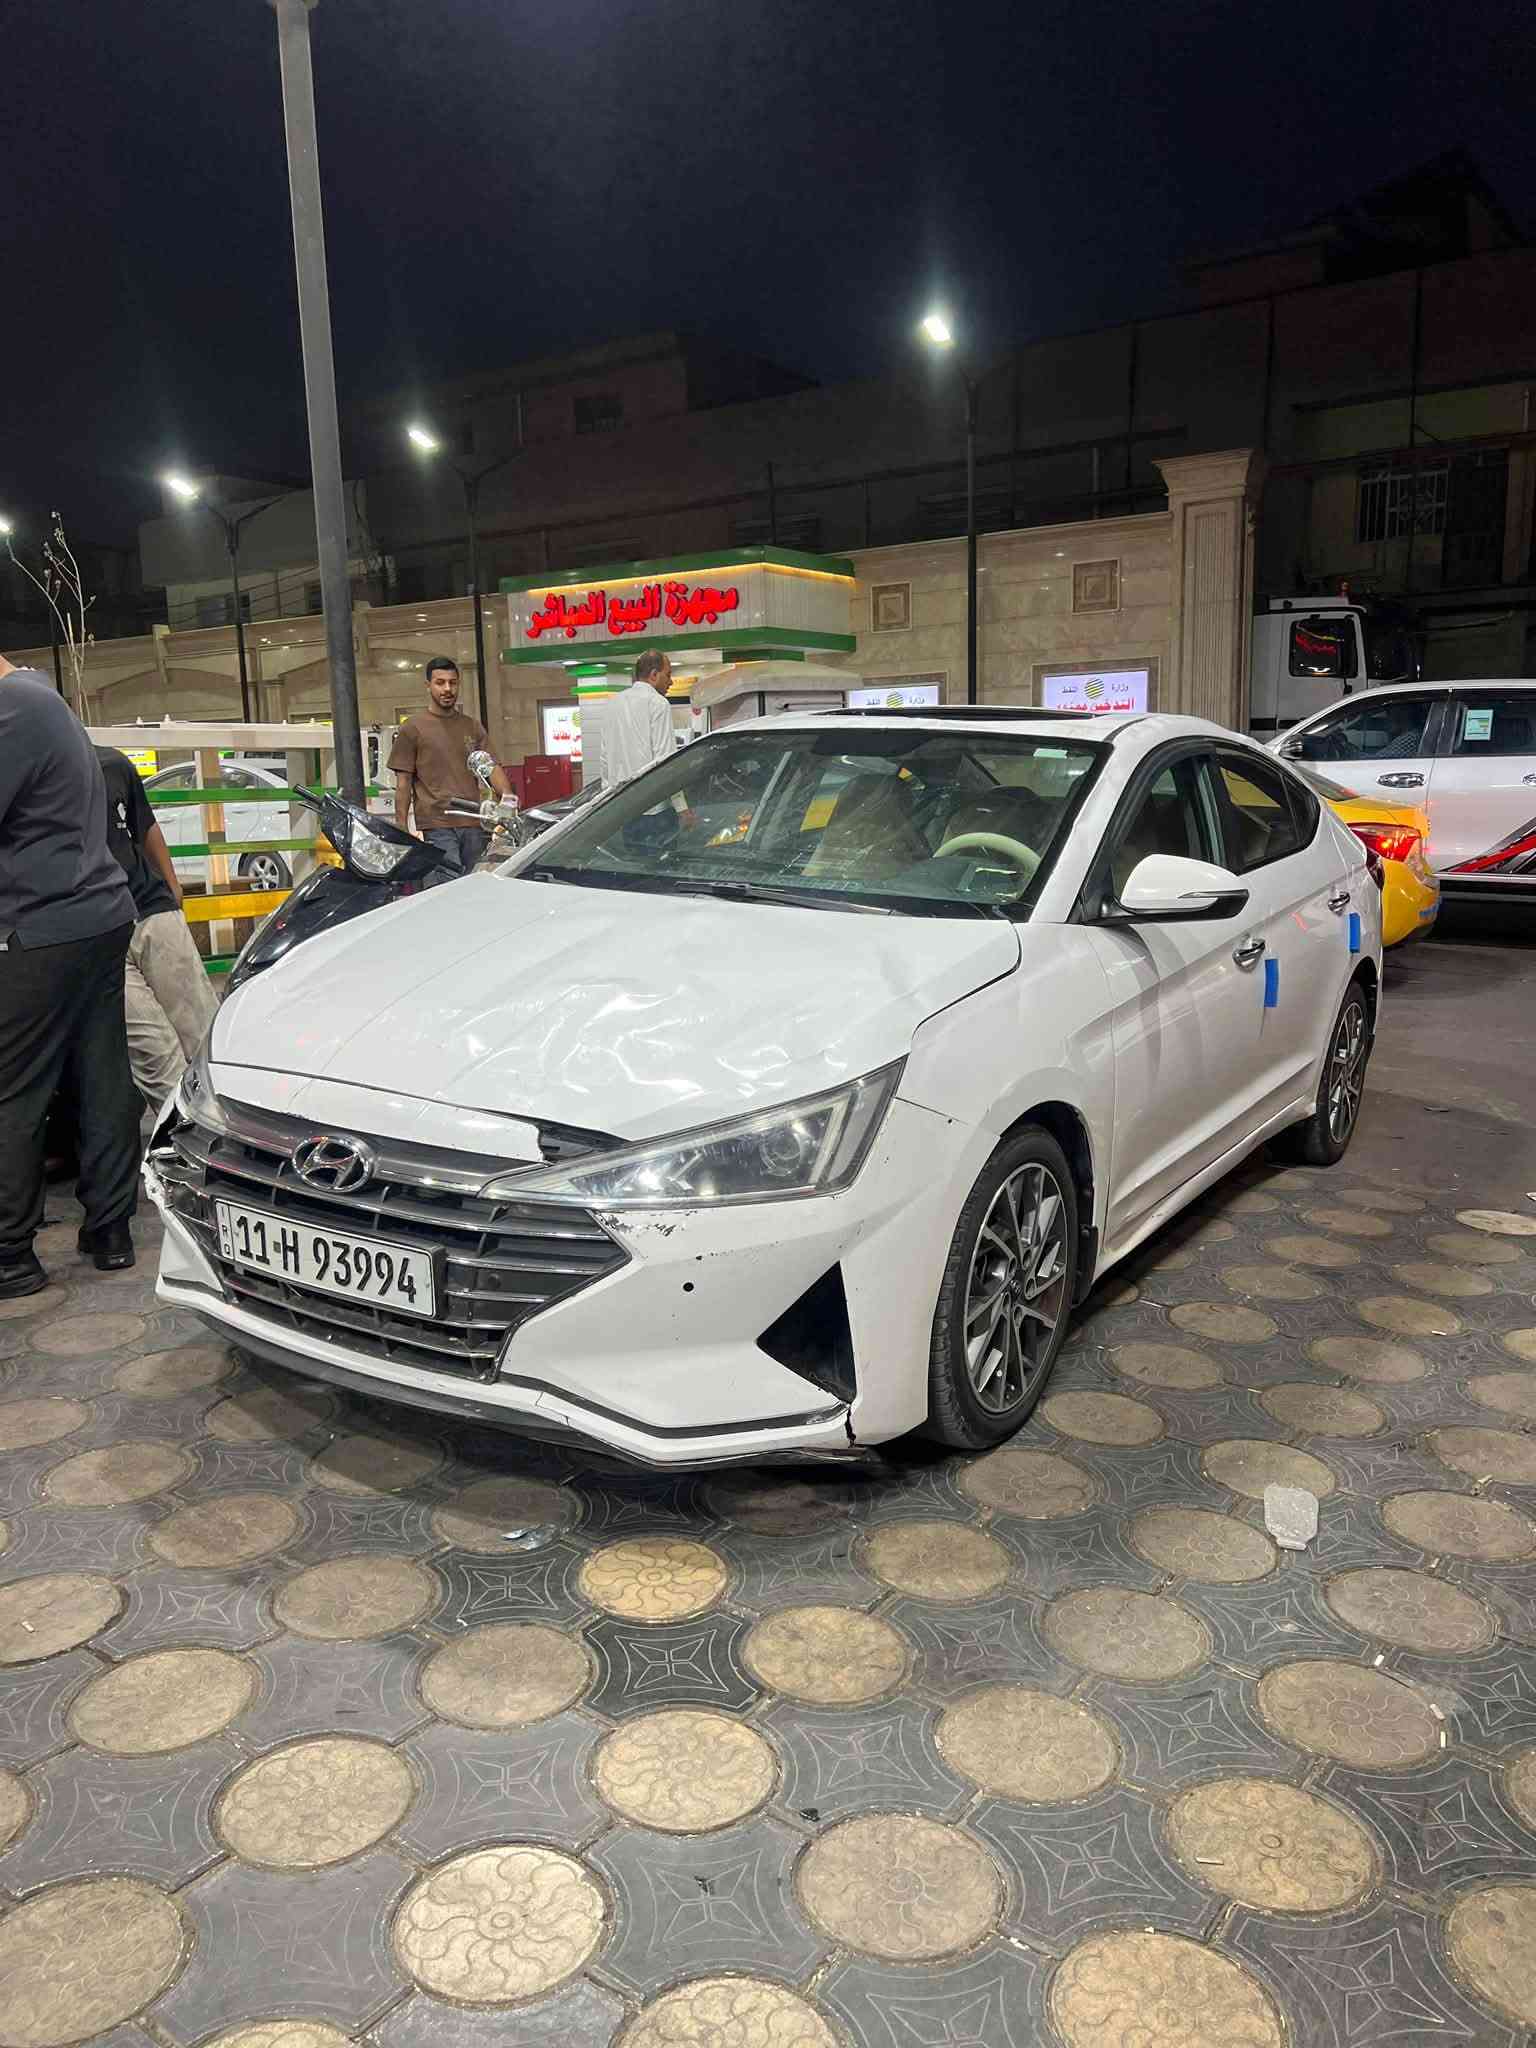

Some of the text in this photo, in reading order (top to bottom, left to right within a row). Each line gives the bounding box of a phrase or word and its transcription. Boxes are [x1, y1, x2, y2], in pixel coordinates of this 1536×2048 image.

[526, 581, 740, 639] مجهزة البيع المباشر
[236, 1215, 417, 1304] 11 H 93994
